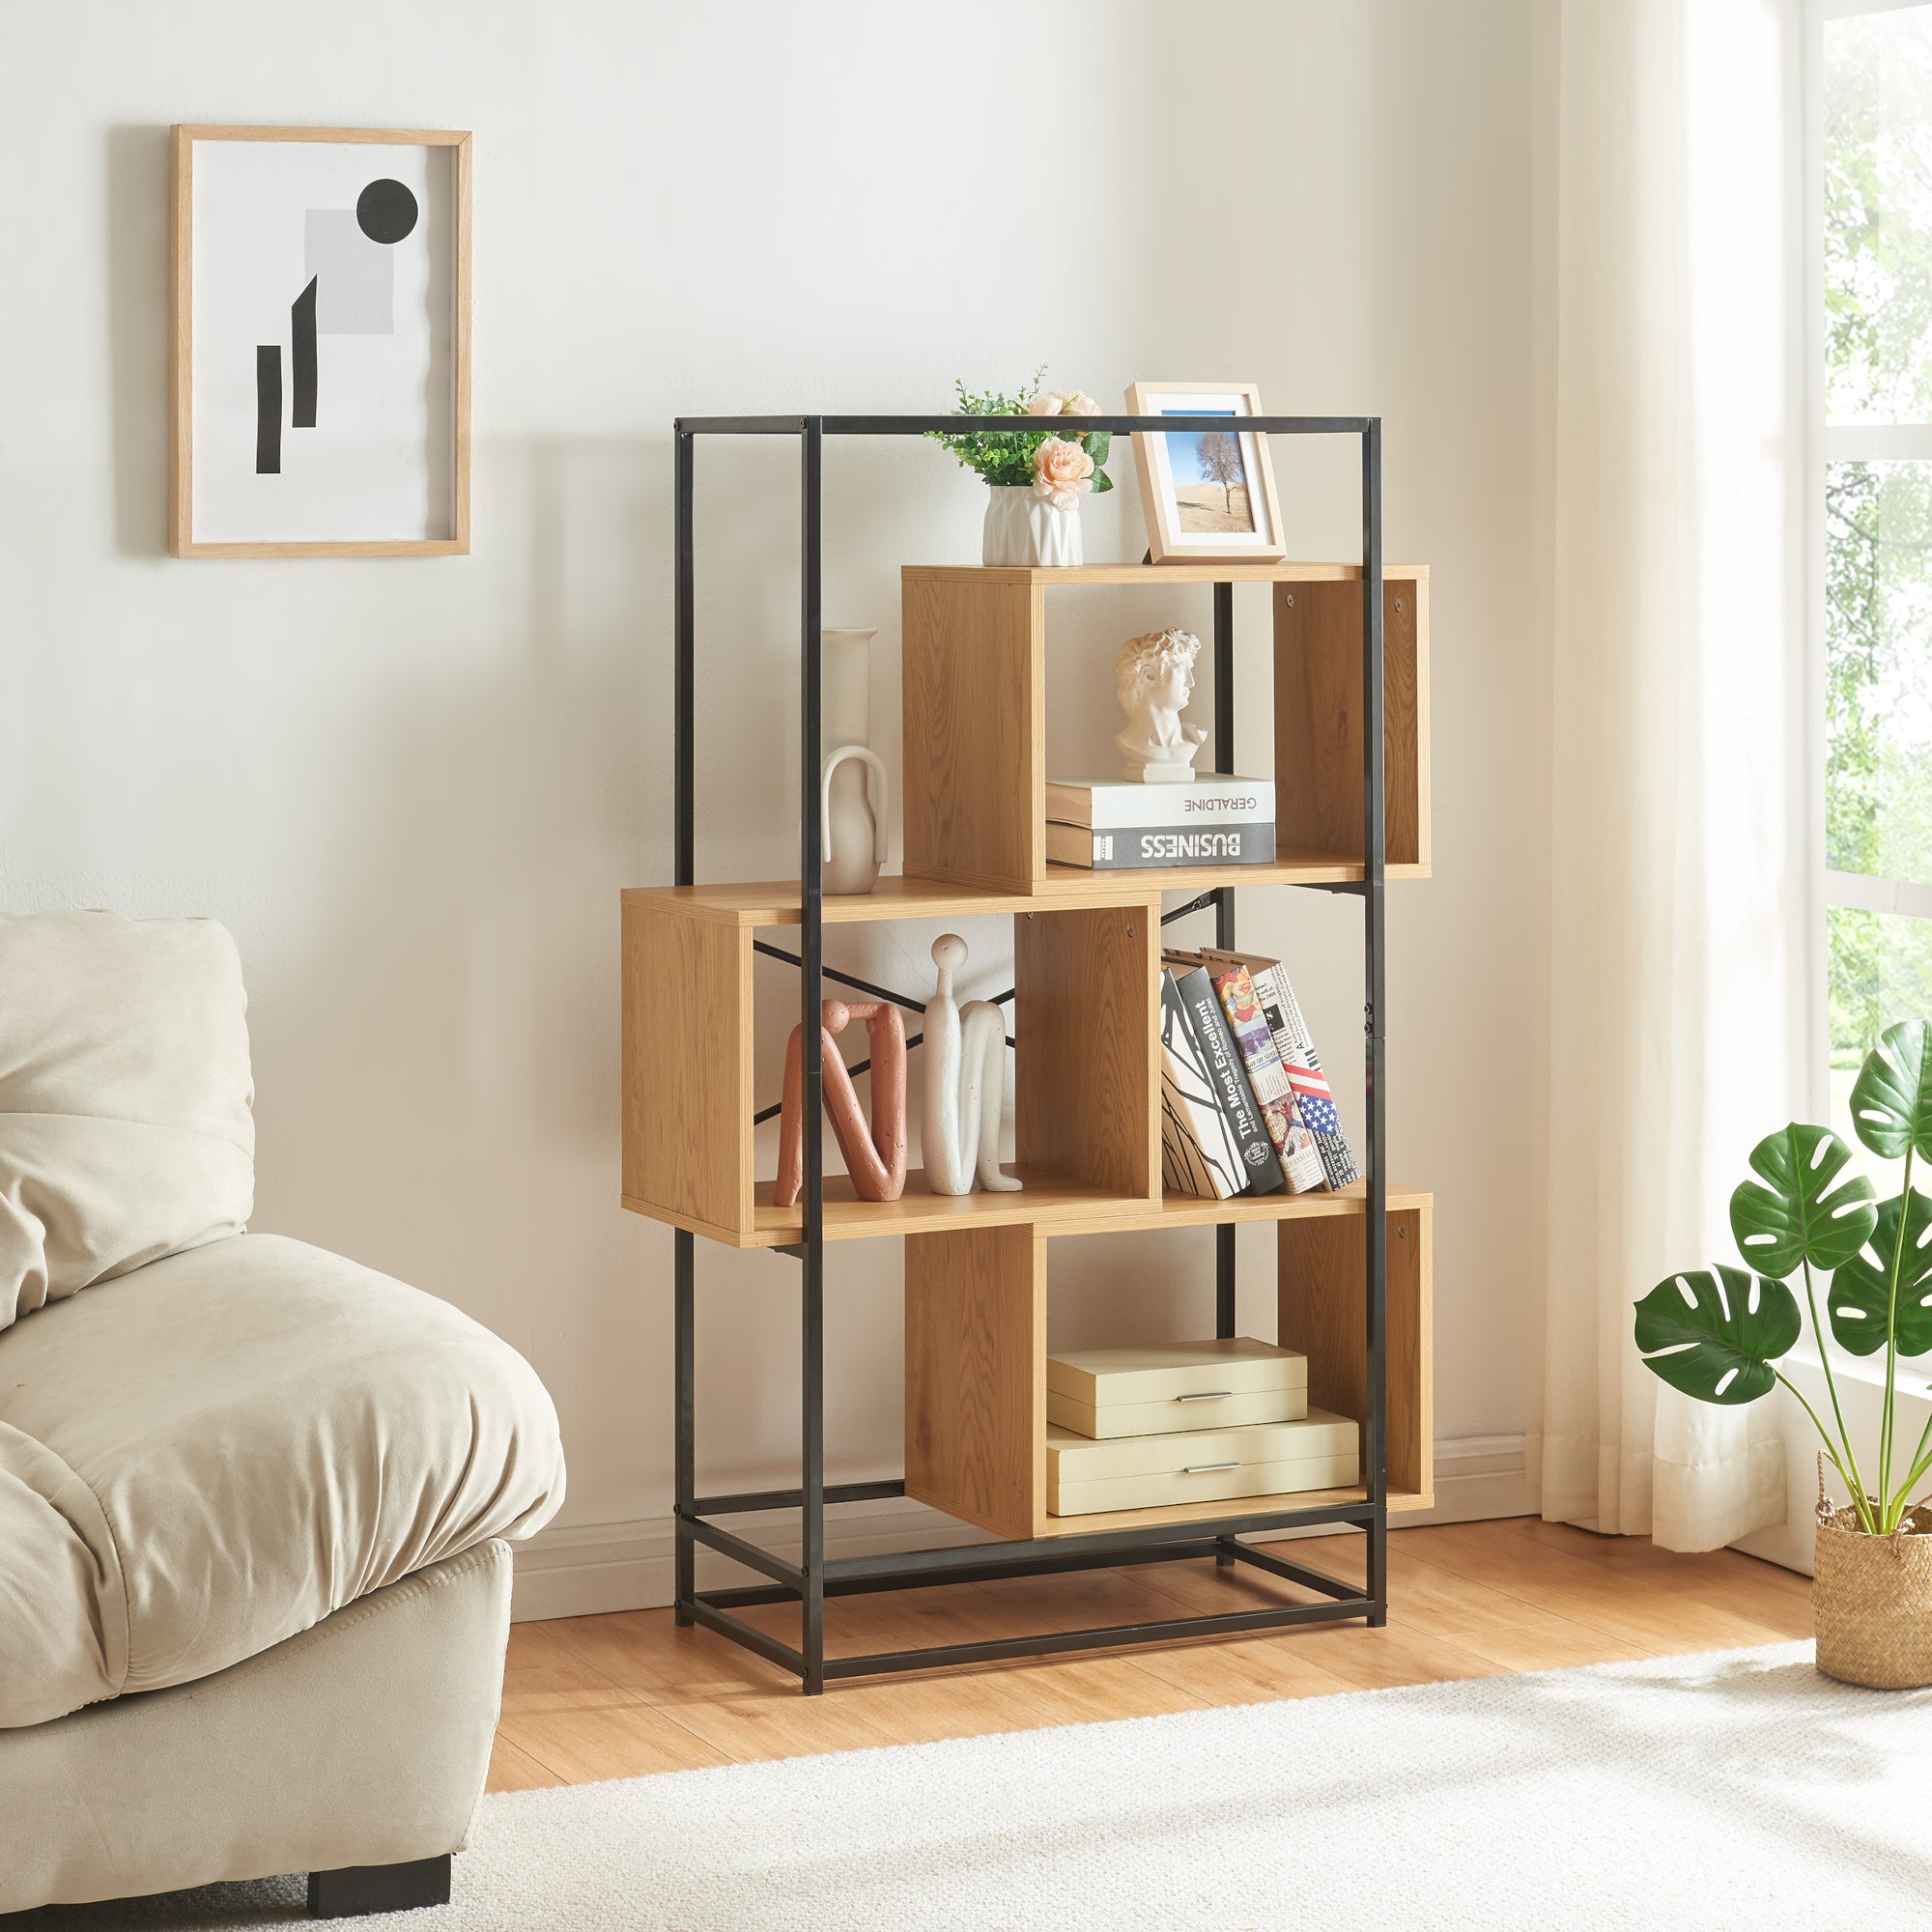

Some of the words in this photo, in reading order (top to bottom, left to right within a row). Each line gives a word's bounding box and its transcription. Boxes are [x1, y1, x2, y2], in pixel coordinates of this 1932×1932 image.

[1184, 797, 1257, 812] GERALDINE
[1141, 833, 1240, 858] BUSINESS
[1205, 997, 1215, 1014] Juliet
[1211, 1014, 1220, 1027] and
[1192, 999, 1228, 1068] Excellent
[1215, 1027, 1228, 1050] Romeo
[1227, 1058, 1241, 1084] Tragedy
[1217, 1069, 1241, 1108] Most
[1236, 1083, 1254, 1120] Lamentable
[1232, 1109, 1252, 1138] The
[1249, 1120, 1258, 1132] and
